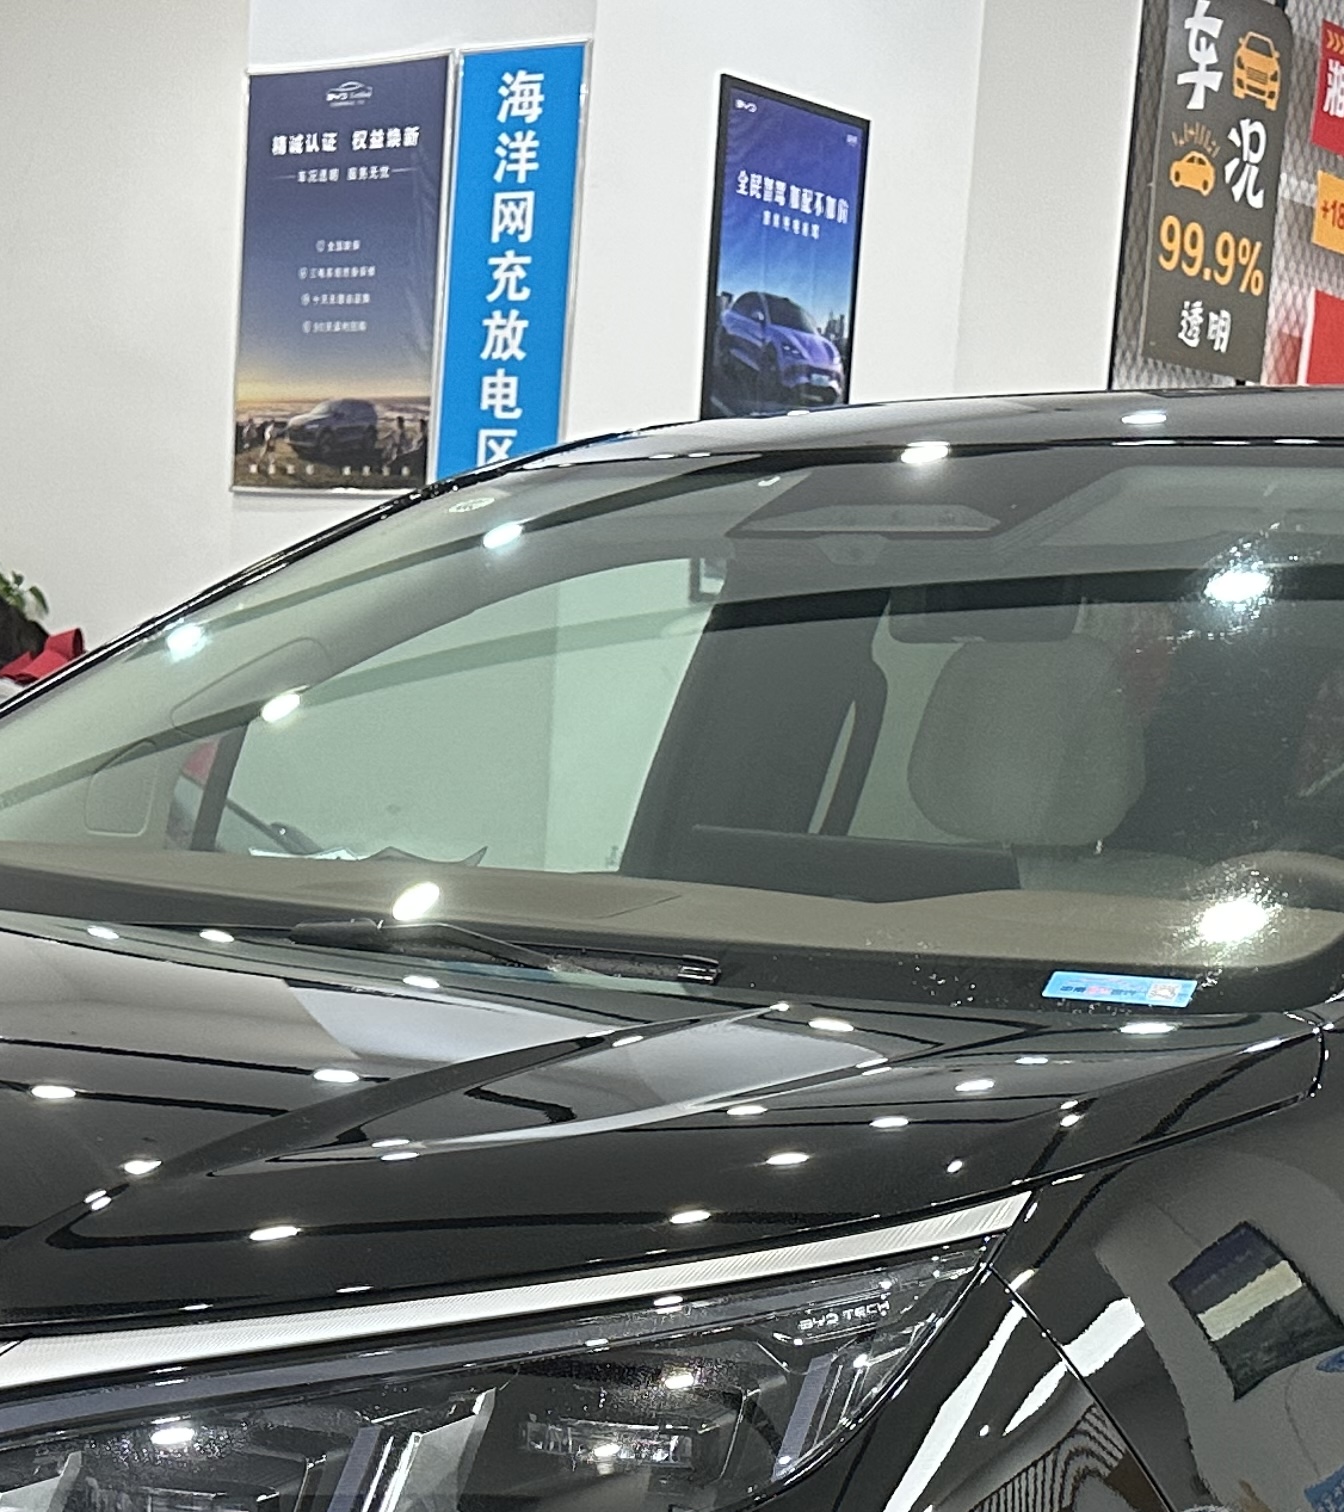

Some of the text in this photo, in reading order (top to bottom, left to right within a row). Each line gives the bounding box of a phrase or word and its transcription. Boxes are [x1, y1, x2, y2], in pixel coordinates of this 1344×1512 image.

[476, 70, 545, 467] 海洋网充放电区
[1158, 214, 1264, 297] 99.9%
[1177, 300, 1232, 353] 透明
[799, 1300, 890, 1331] BYD TECH
